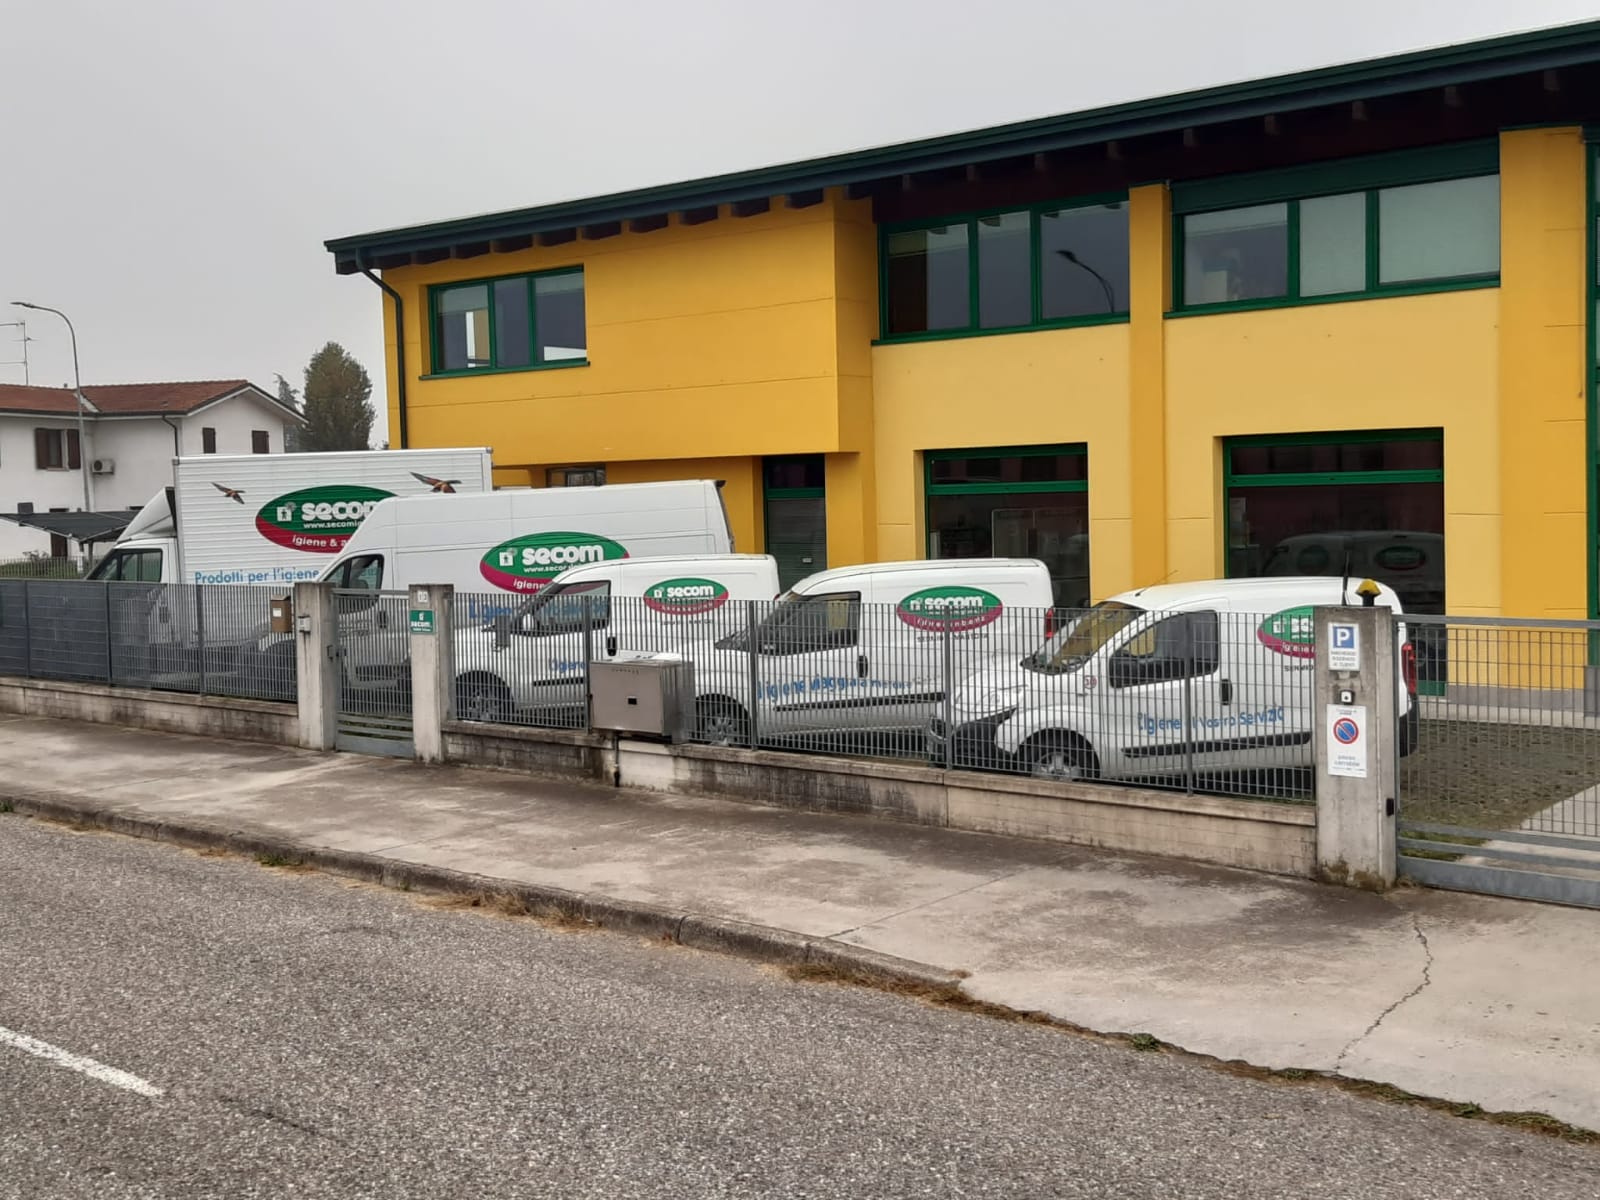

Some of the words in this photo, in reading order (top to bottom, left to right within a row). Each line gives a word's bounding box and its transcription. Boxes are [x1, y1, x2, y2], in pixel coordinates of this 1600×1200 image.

[292, 535, 327, 548] igiene
[522, 544, 604, 566] secom
[194, 569, 243, 584] Prodotti
[248, 571, 269, 584] per
[667, 585, 714, 598] secom
[925, 596, 983, 610] secom
[1337, 628, 1350, 647] P
